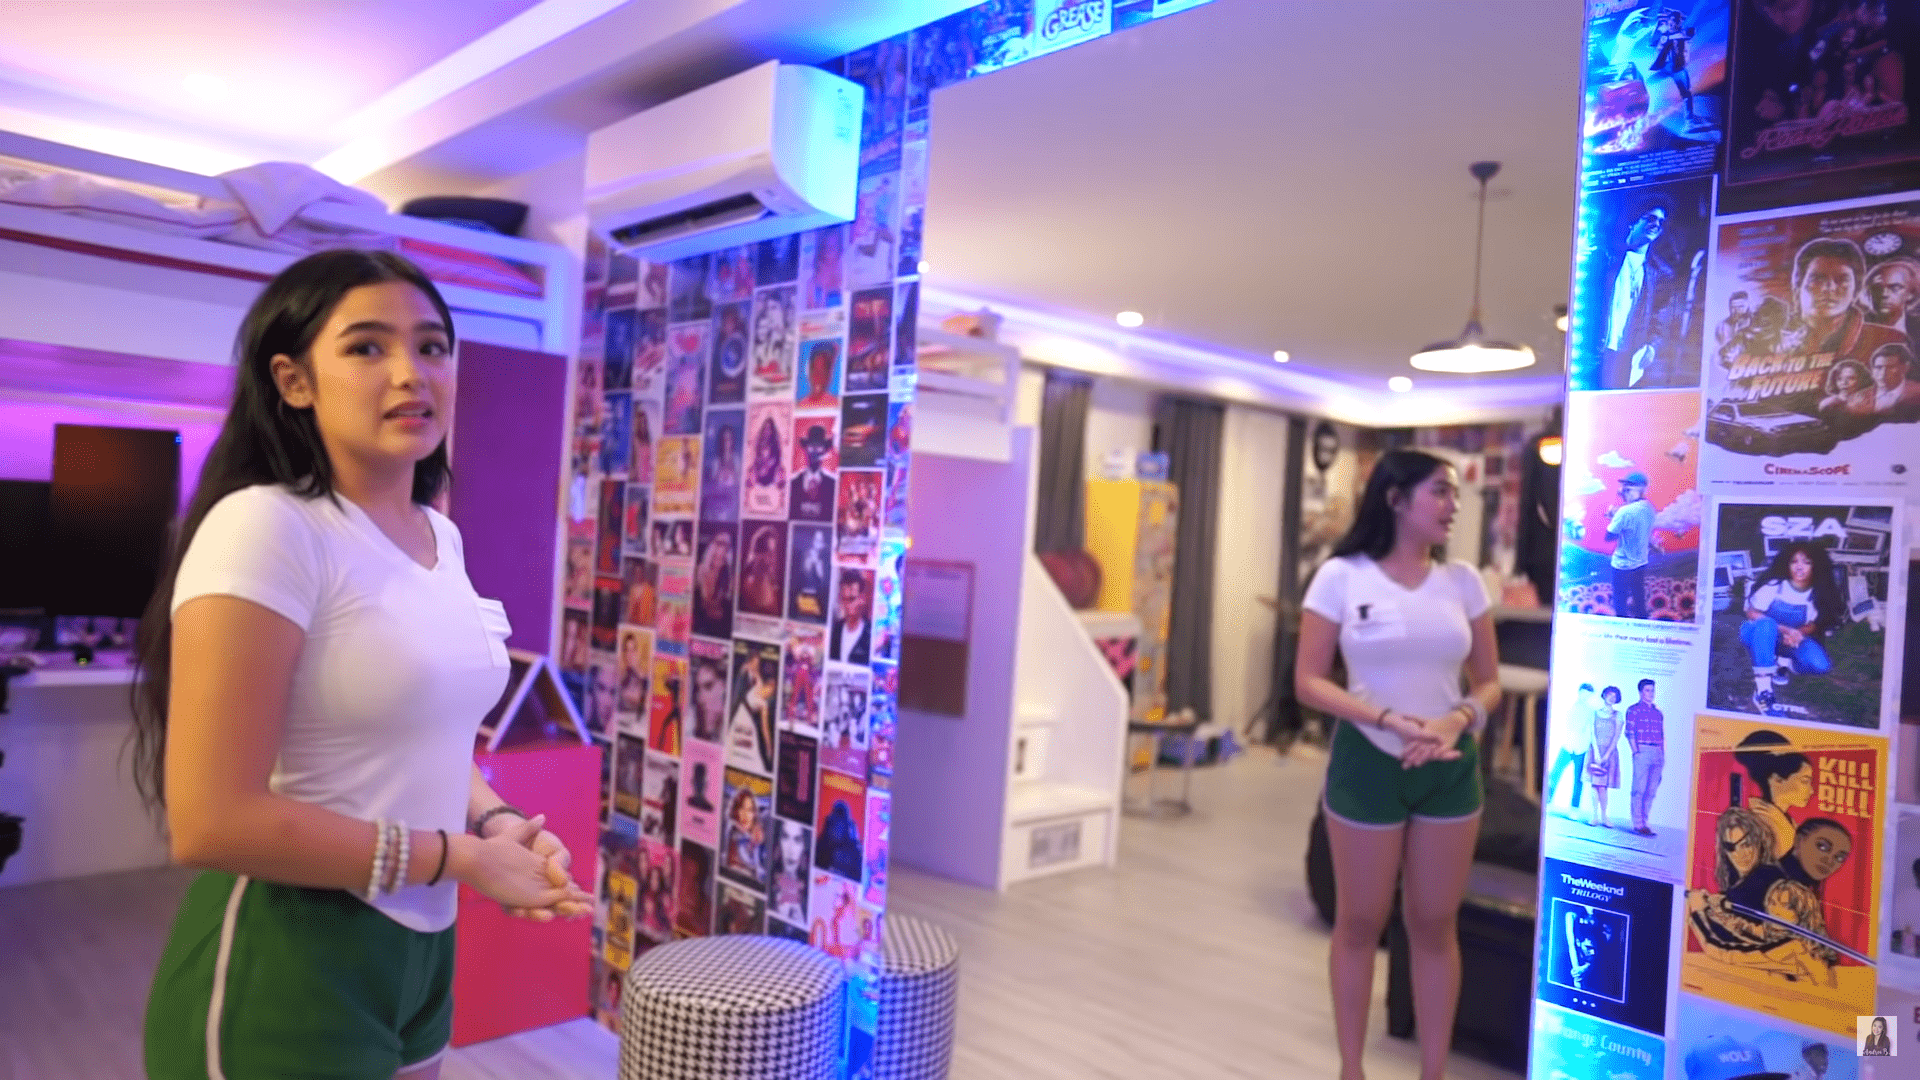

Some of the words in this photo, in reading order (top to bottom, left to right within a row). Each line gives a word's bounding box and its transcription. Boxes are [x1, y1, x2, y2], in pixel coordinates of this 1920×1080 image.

[1042, 1, 1104, 40] GREASE
[1728, 353, 1787, 381] BACK
[1747, 370, 1825, 401] FUTURE
[1761, 516, 1848, 538] SZA
[1818, 756, 1874, 791] KILL
[1818, 784, 1873, 818] BILL
[1570, 886, 1612, 903] TRILOGY
